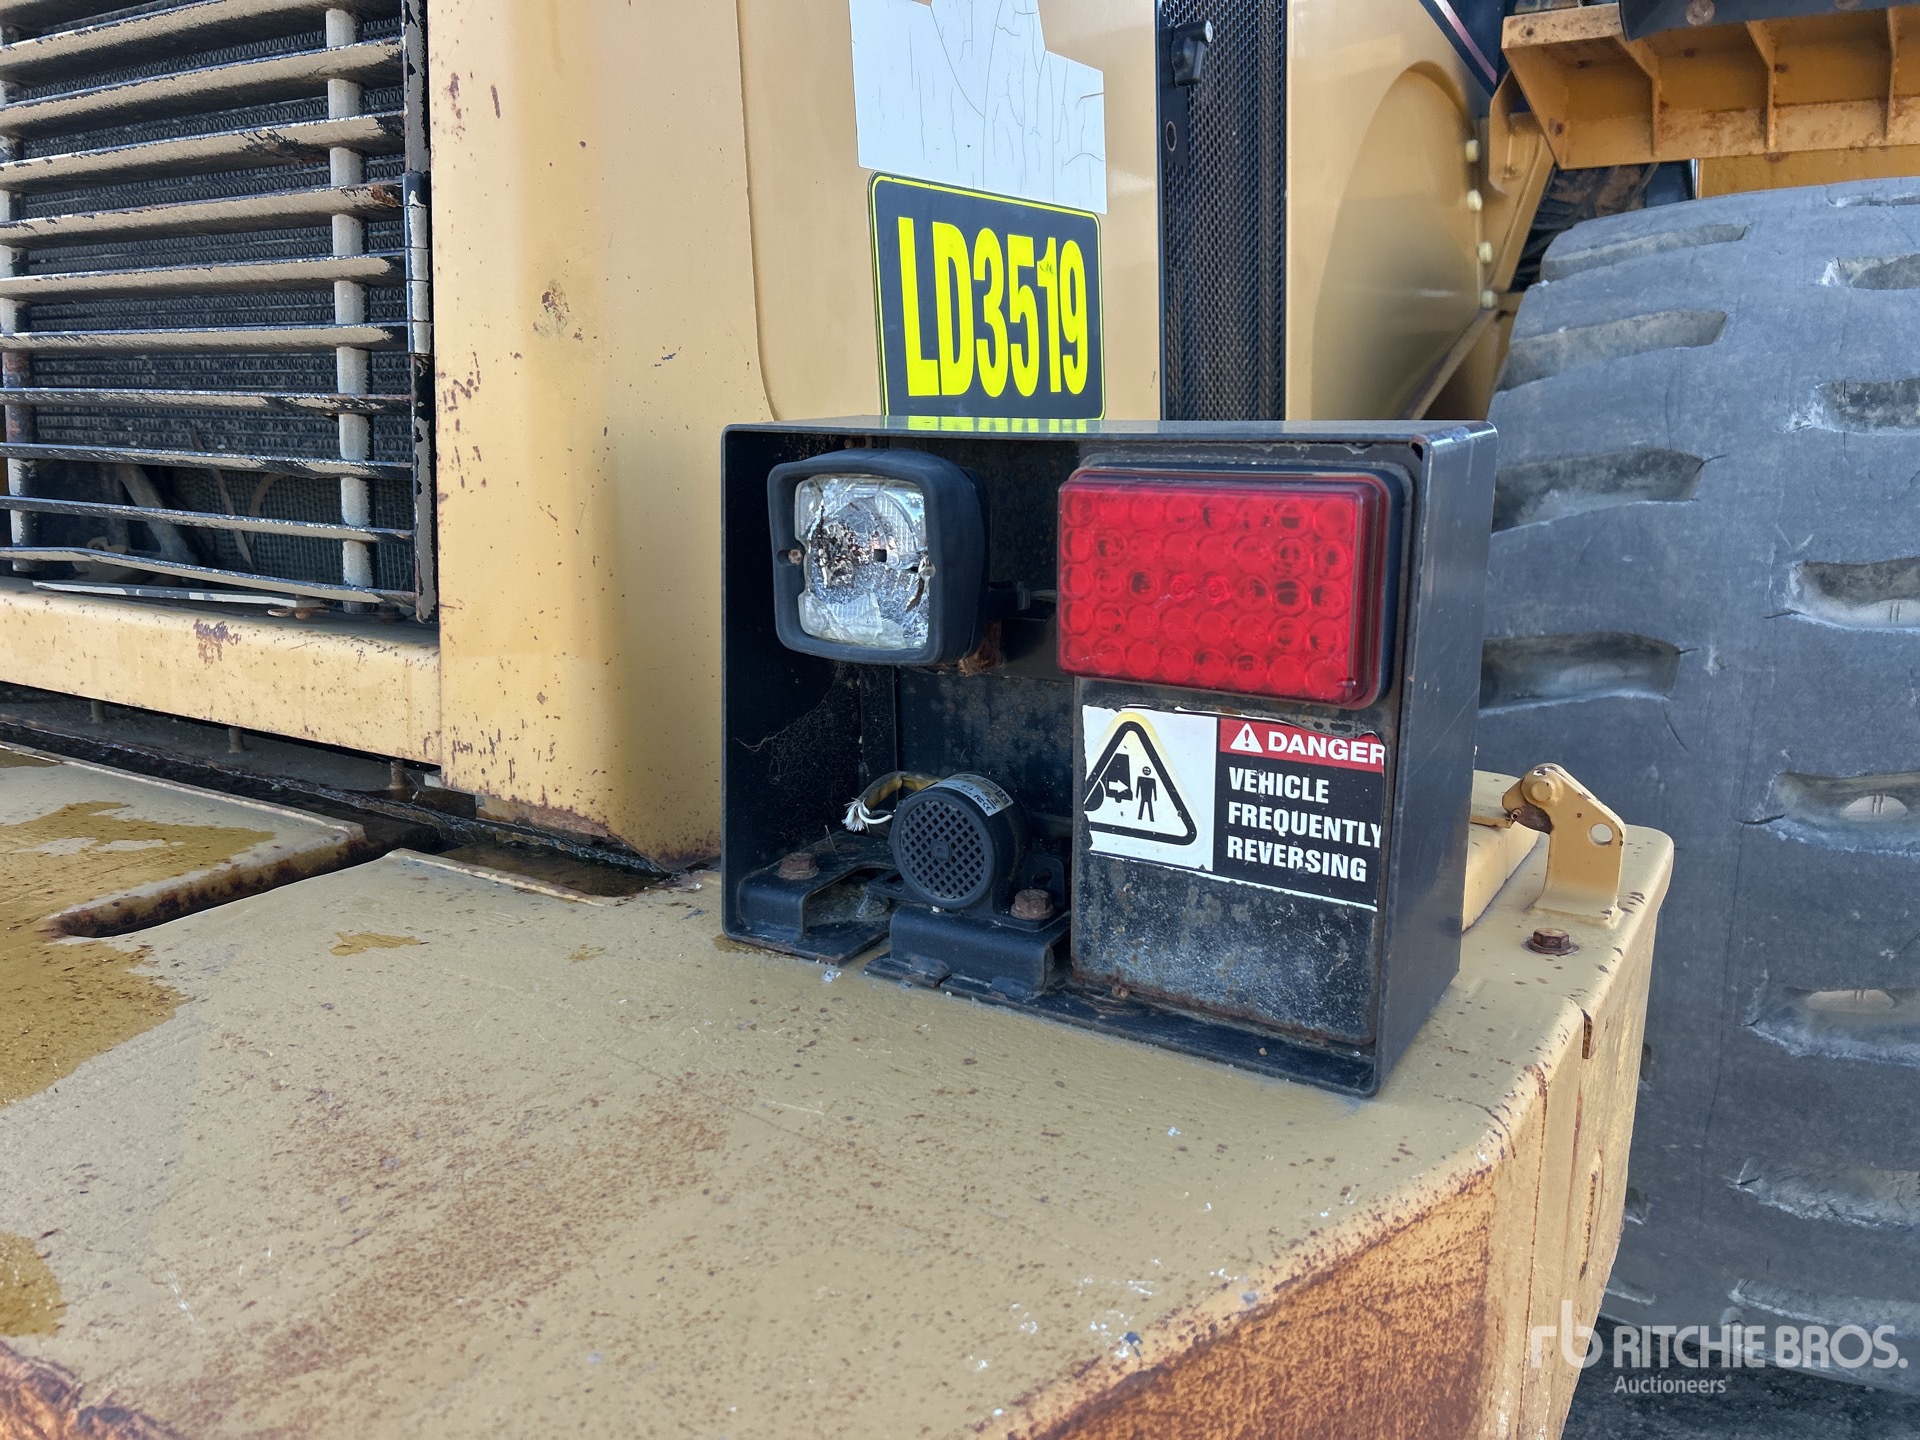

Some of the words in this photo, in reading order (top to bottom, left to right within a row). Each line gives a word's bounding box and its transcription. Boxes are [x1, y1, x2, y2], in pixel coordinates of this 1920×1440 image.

[898, 216, 1088, 397] LD3519
[1268, 731, 1385, 766] DANGER
[1229, 766, 1329, 804] VEHICLE
[1228, 801, 1381, 848] FREQUENTLY
[1227, 836, 1367, 882] REVERSING
